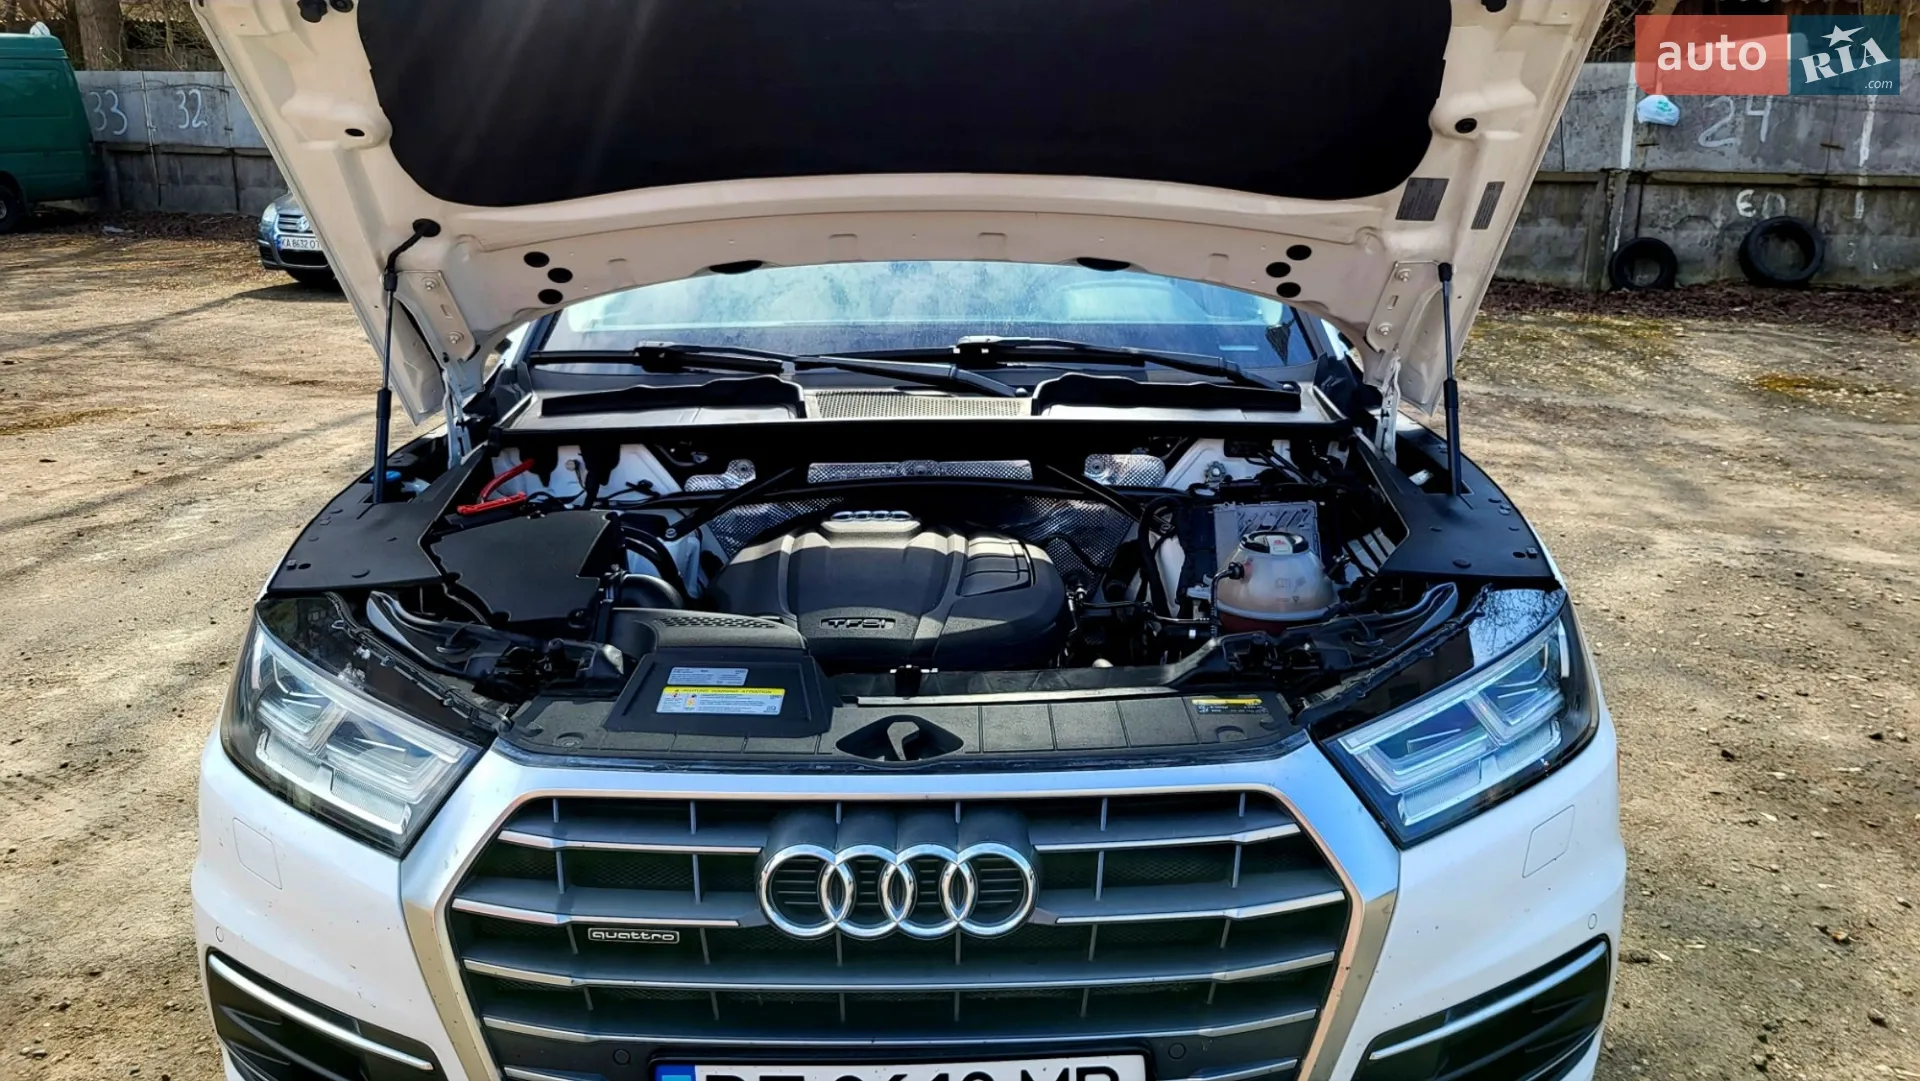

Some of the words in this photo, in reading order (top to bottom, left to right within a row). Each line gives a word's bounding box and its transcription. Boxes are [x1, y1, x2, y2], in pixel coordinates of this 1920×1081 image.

[89, 89, 128, 135] 33
[176, 88, 208, 129] 32
[1699, 95, 1774, 148] 24
[827, 618, 886, 629] TFSI
[592, 931, 675, 941] quattro
